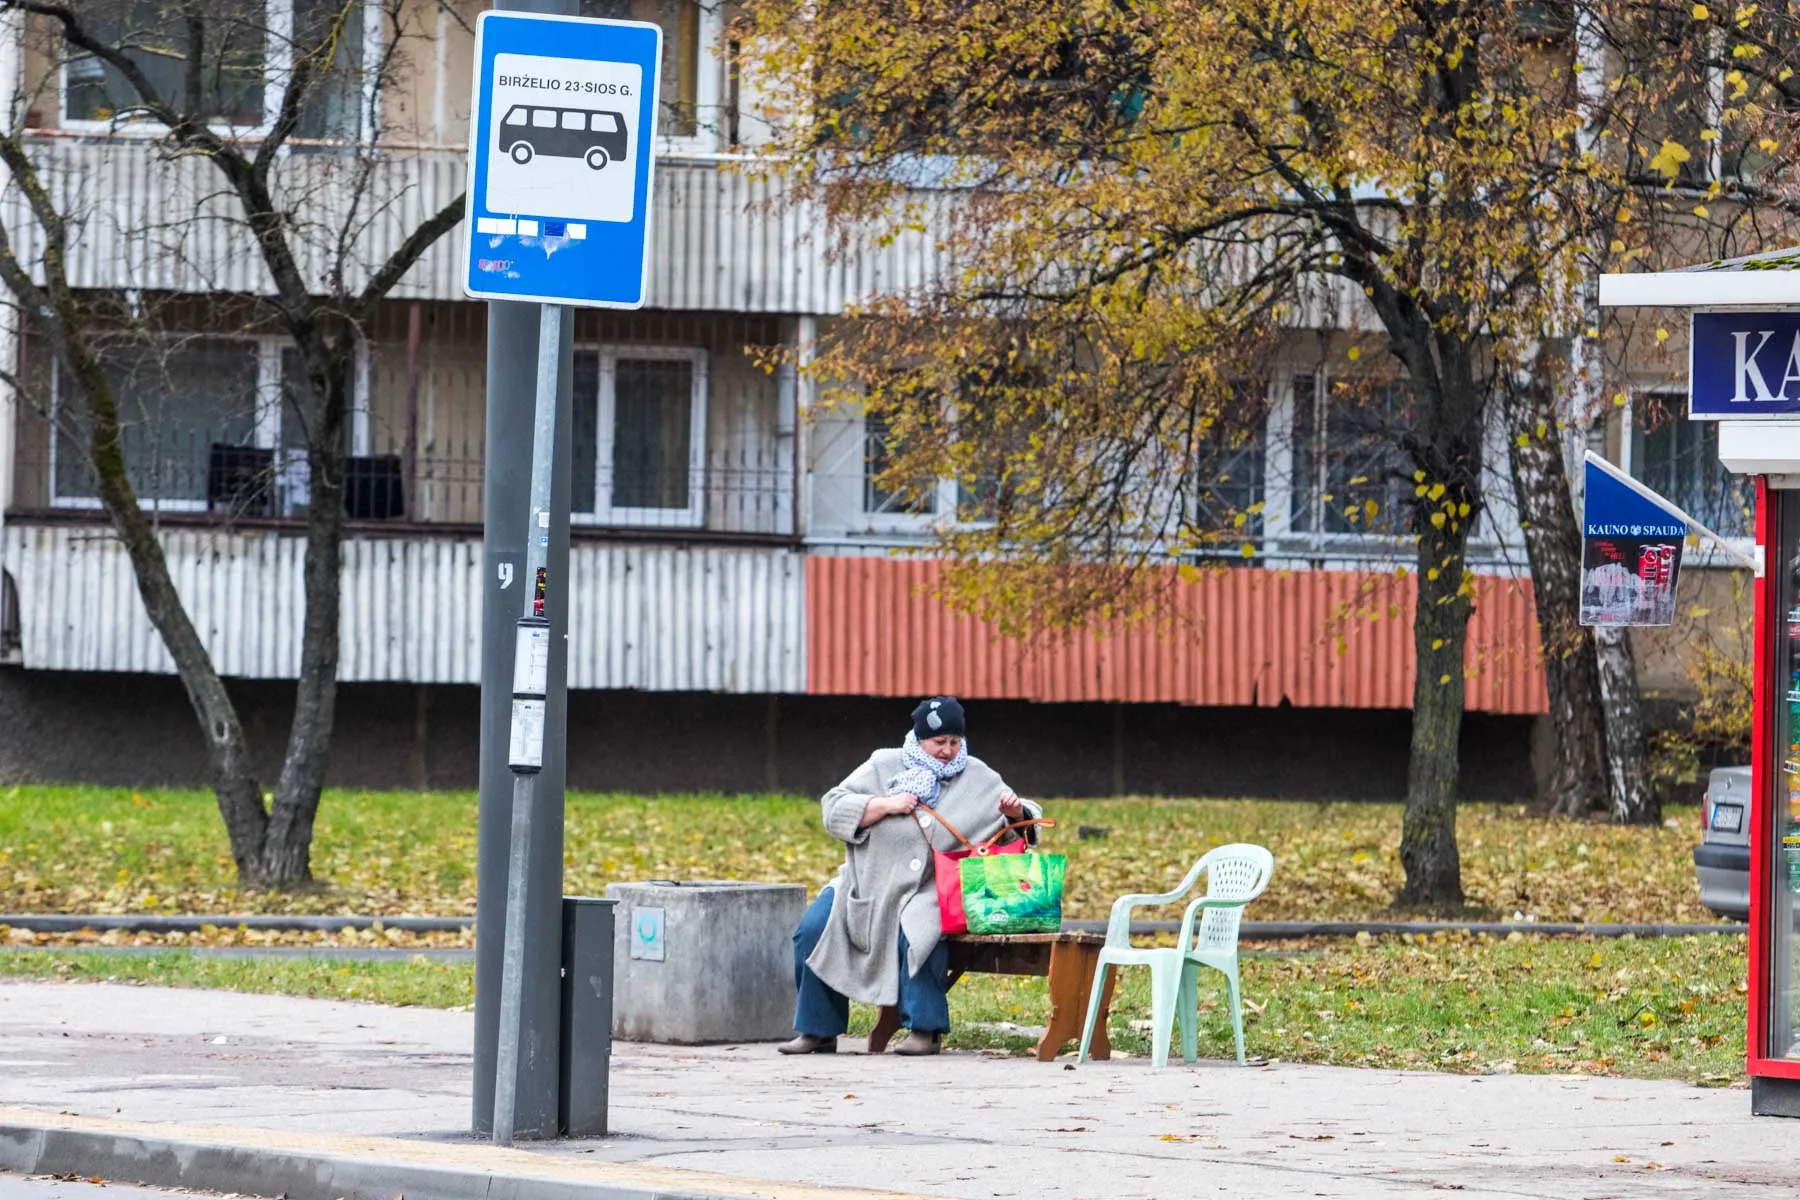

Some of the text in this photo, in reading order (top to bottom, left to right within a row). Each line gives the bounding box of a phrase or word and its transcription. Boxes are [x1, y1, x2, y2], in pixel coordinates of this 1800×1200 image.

[619, 84, 633, 96] G.
[1588, 524, 1684, 536] KAUNO SPAUDA
